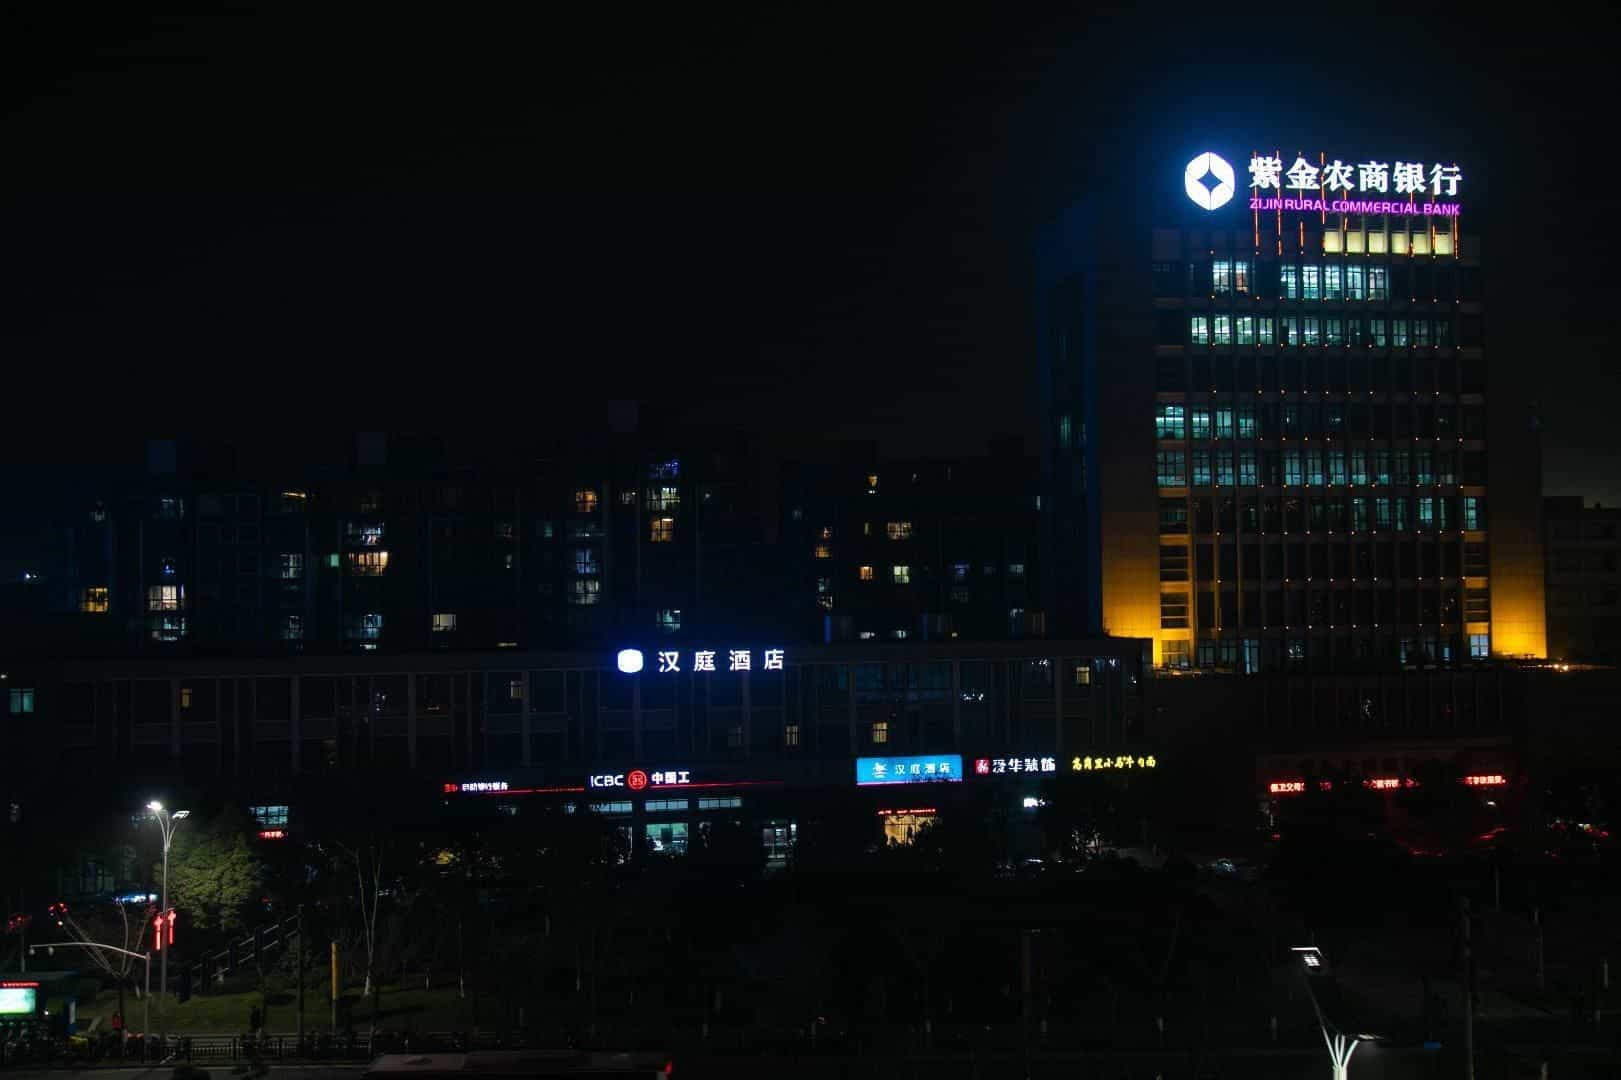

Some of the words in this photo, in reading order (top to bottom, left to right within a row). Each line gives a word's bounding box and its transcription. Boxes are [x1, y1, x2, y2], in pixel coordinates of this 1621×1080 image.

[1249, 156, 1463, 196] 紫金农商银行
[1250, 198, 1283, 210] ZIJIN
[1285, 199, 1331, 212] RURAL
[1332, 200, 1423, 215] COMMERCIAL
[1424, 203, 1460, 216] BANK
[658, 649, 785, 673] 汉庭酒店
[590, 775, 624, 787] ICBC
